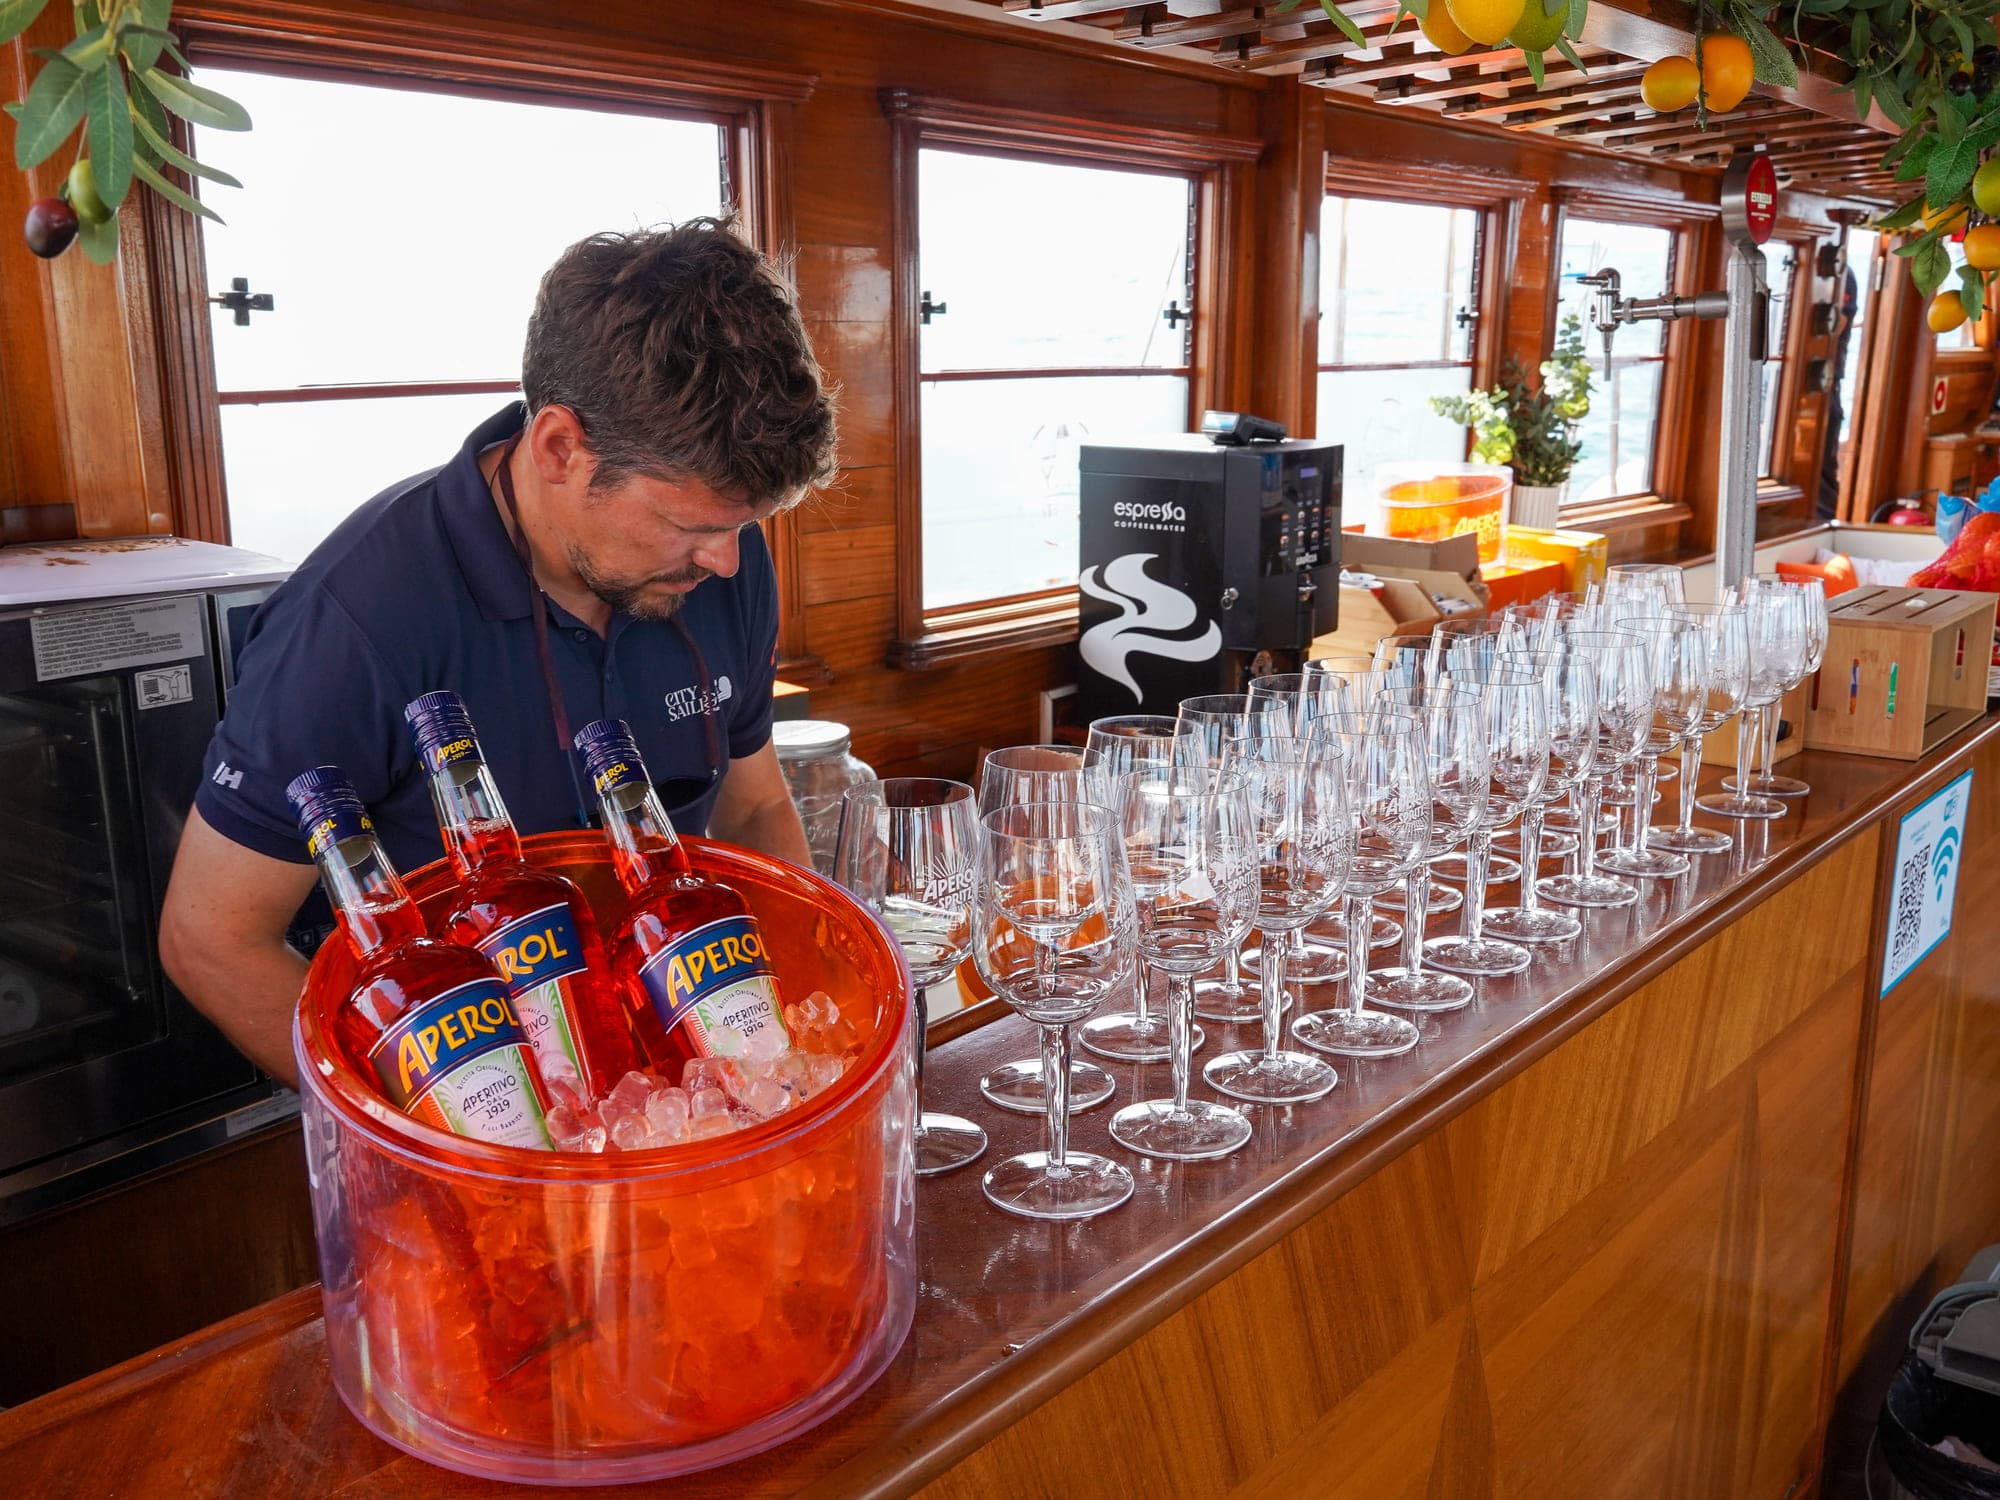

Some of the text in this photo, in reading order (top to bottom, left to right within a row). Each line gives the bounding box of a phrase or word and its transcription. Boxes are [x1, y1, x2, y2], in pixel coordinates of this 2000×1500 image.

[665, 685, 698, 708] CITY
[436, 739, 474, 764] APEROL
[595, 762, 629, 795] APEROL
[922, 868, 973, 903] APERO
[495, 928, 568, 985] ROL
[667, 933, 771, 1009] APEROL
[723, 1001, 769, 1027] APERITIVO
[398, 996, 520, 1094] APEROL
[463, 1075, 516, 1113] APERITIVO
[485, 1099, 510, 1119] 1919
[486, 1096, 503, 1106] DAL
